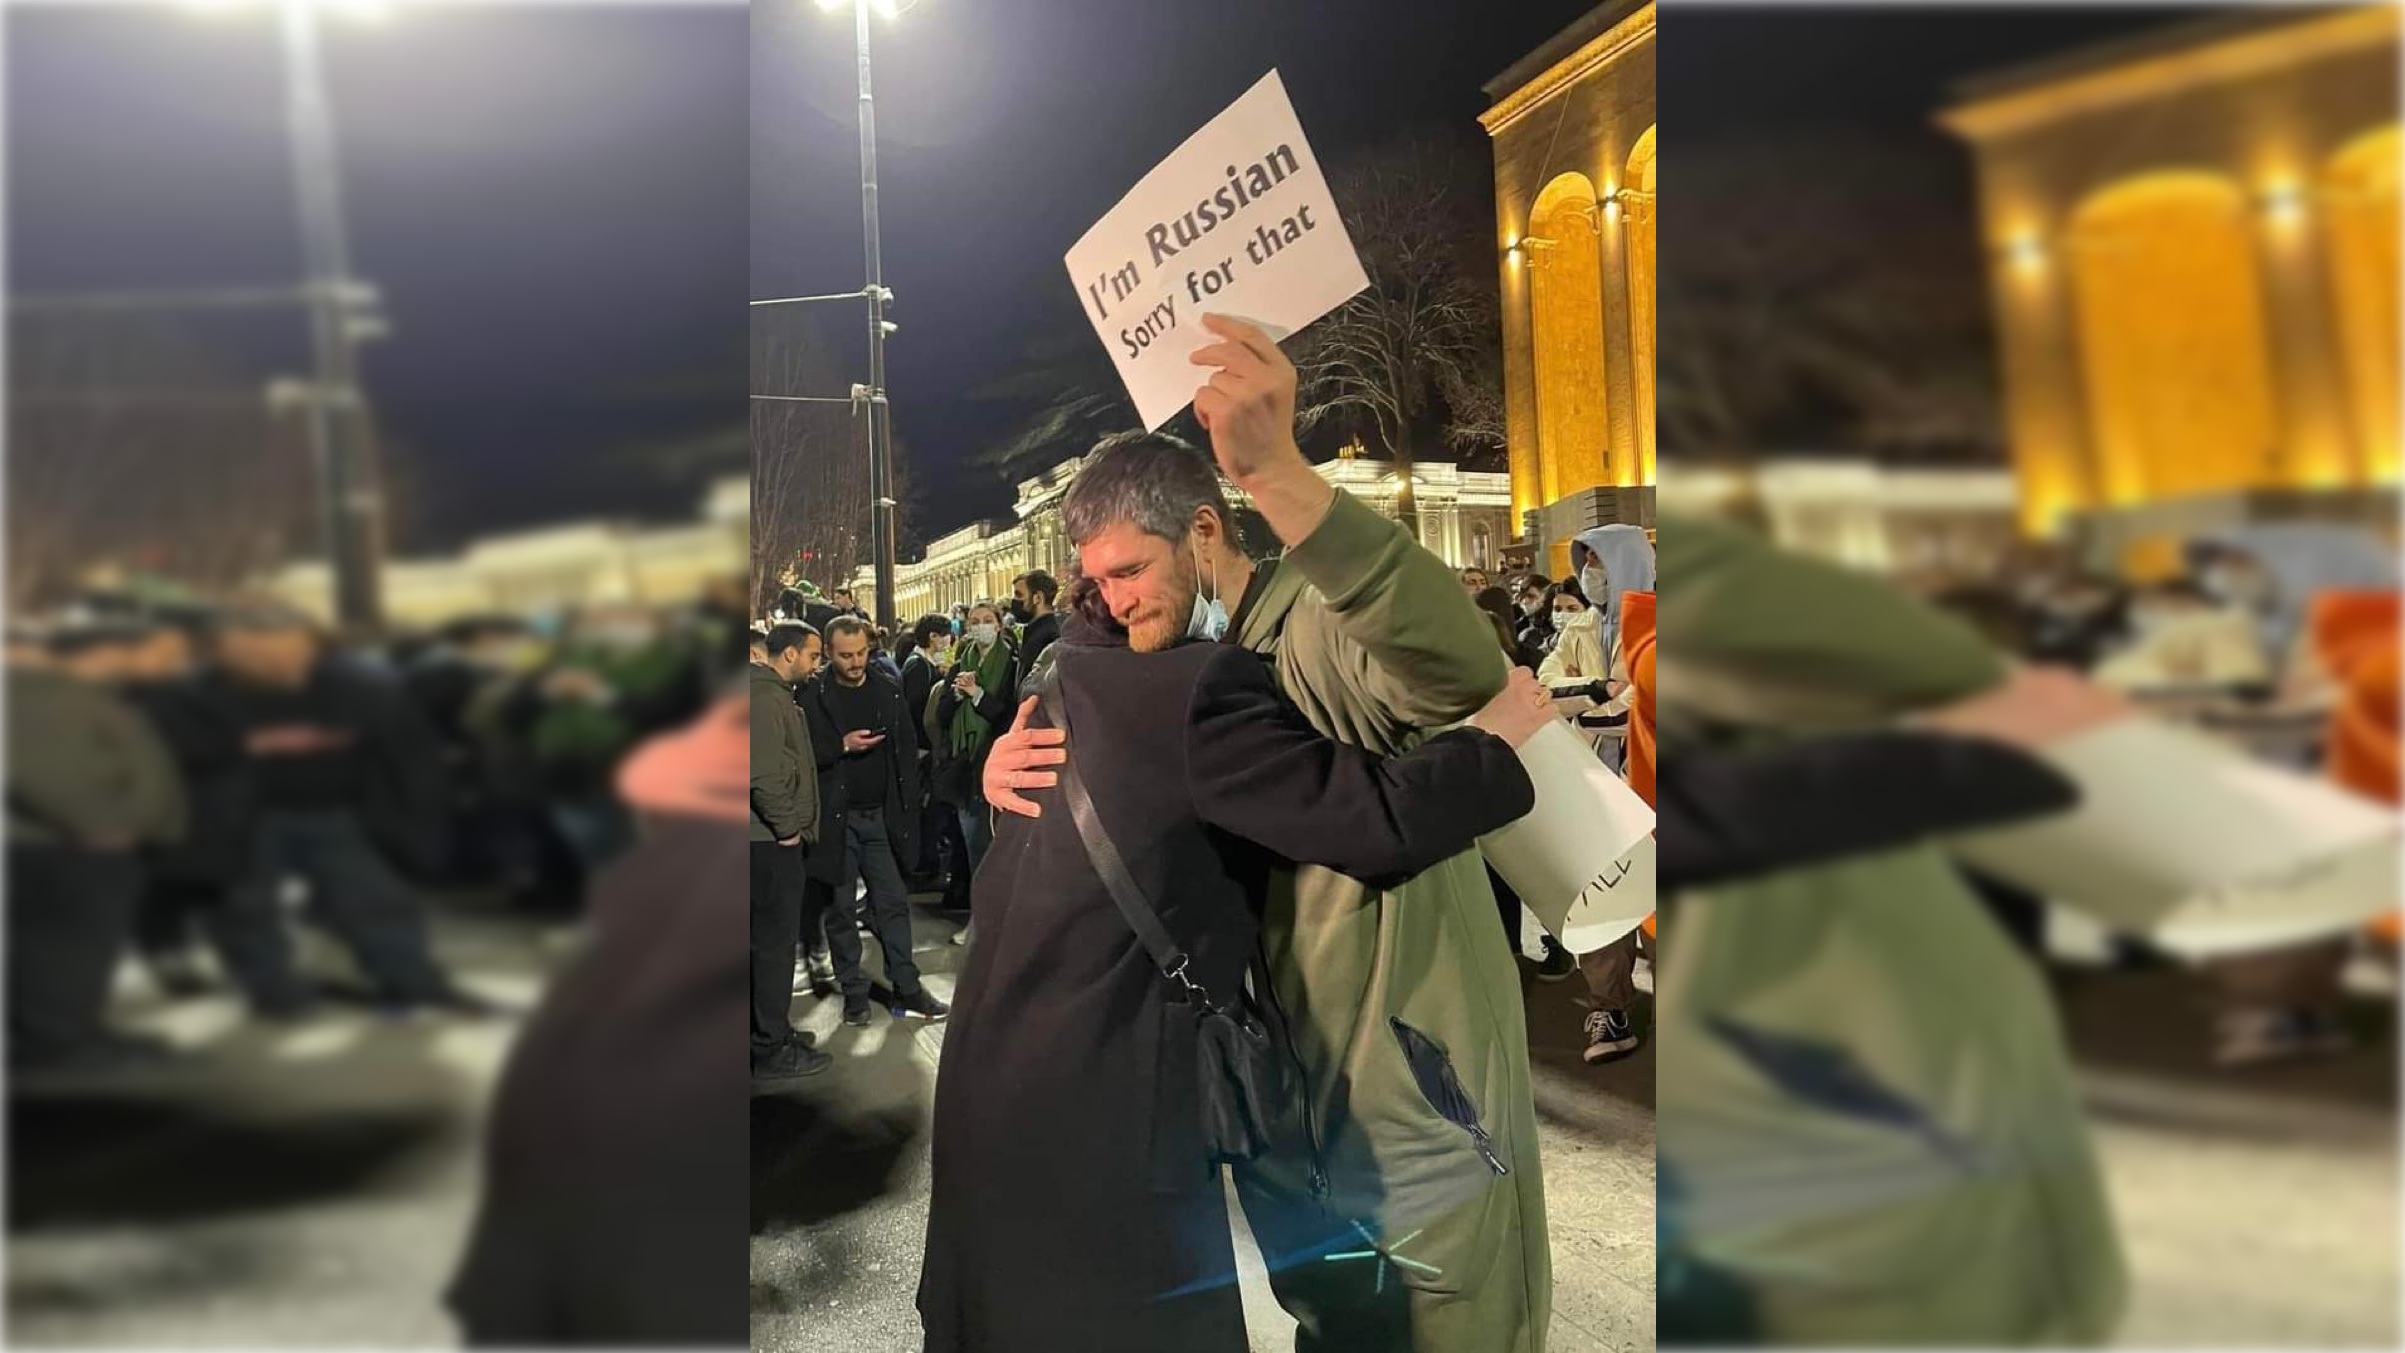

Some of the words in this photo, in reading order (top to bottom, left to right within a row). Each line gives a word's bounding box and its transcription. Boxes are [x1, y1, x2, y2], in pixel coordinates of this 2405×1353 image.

[1089, 260, 1141, 320] I'm
[1145, 143, 1300, 268] Russian
[1121, 295, 1177, 359] Sorry
[1186, 257, 1234, 303] for
[1246, 203, 1316, 266] that
